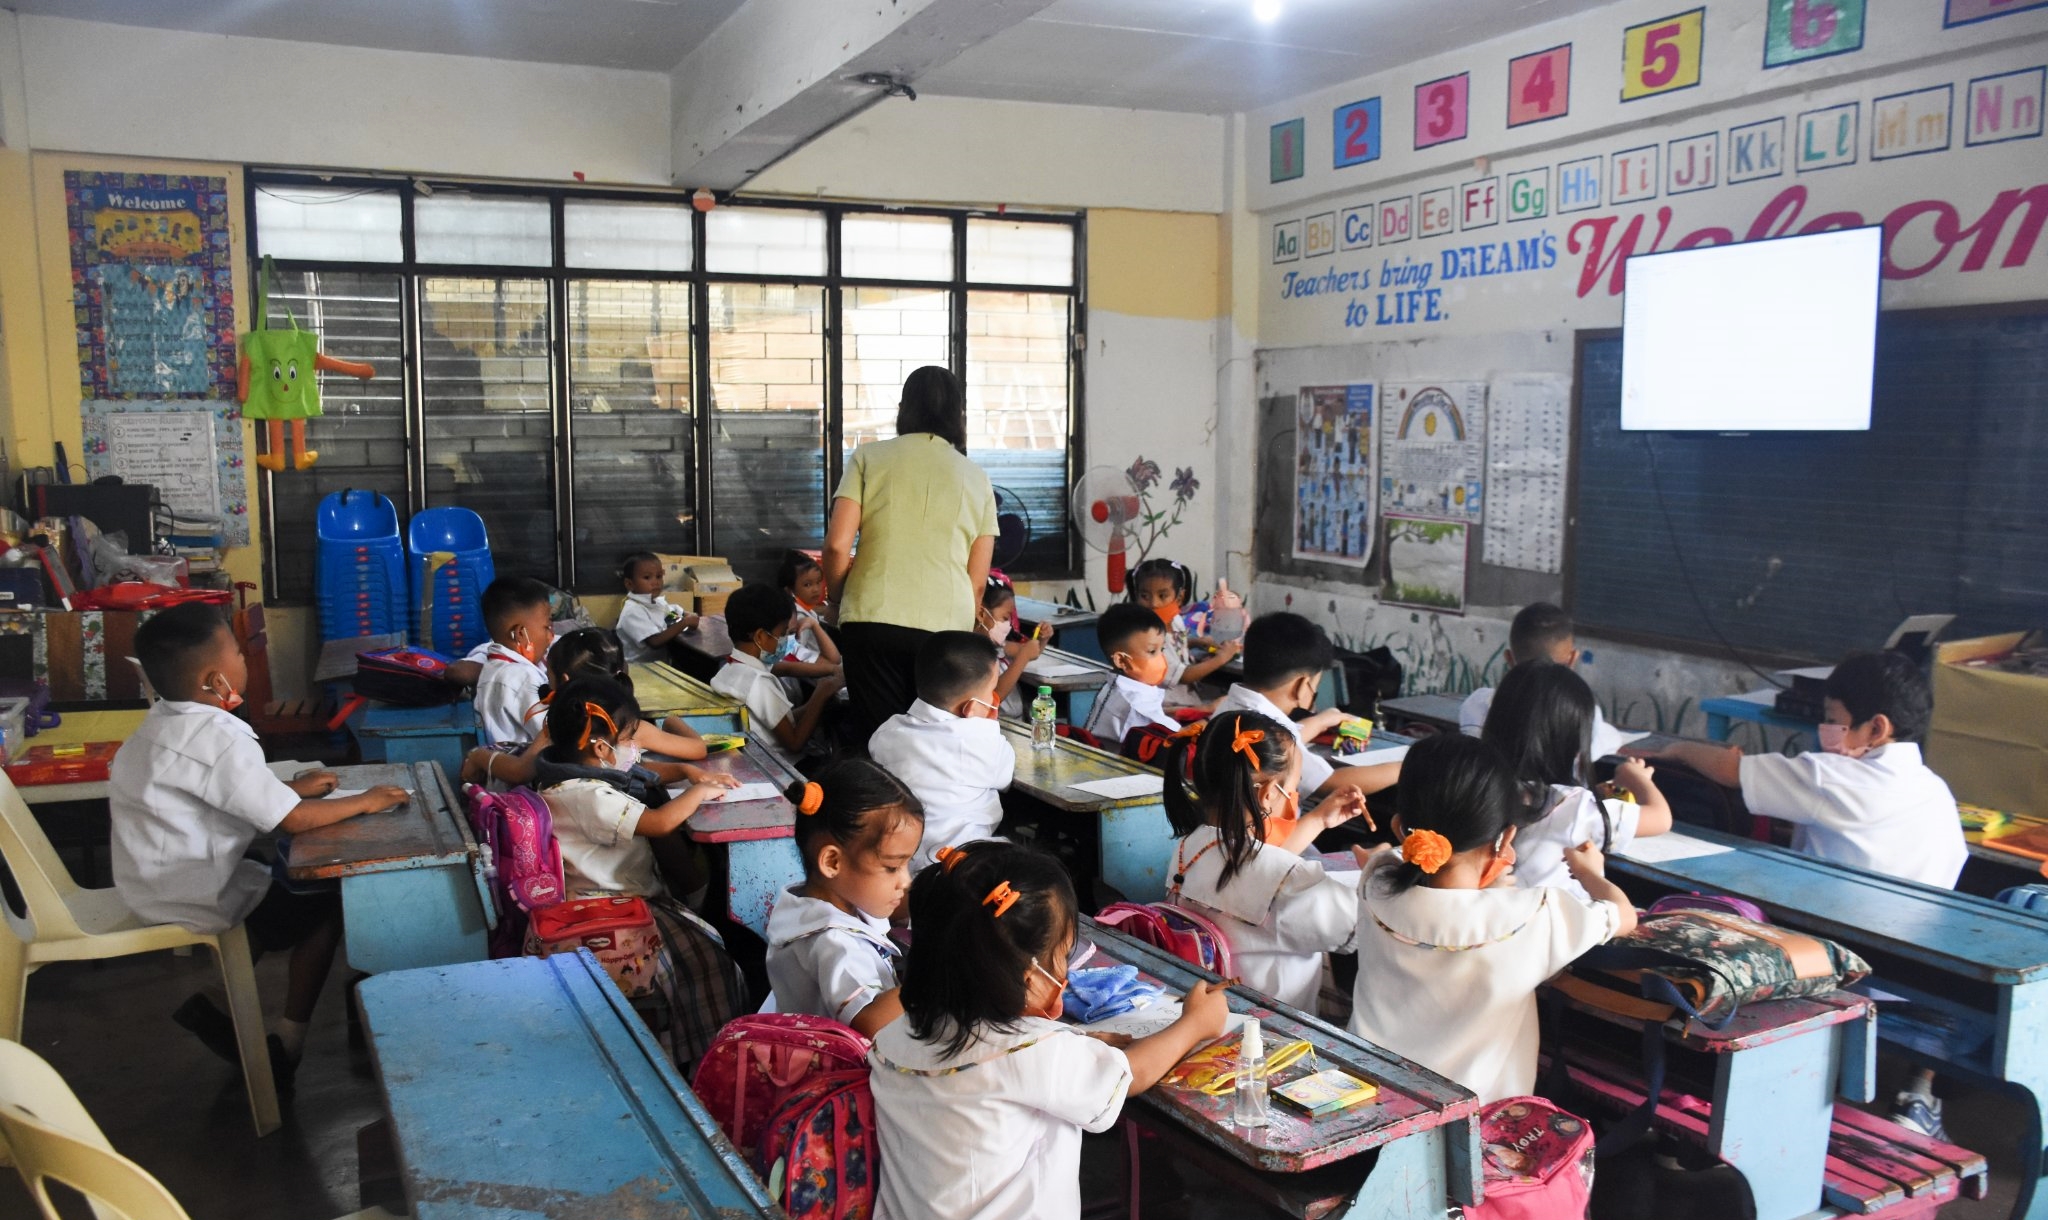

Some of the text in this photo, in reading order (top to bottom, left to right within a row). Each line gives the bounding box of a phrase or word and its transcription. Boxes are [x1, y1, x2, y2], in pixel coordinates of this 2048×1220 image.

[1281, 127, 1293, 173] 1
[1344, 109, 1369, 159] 2
[1428, 84, 1455, 138] 3
[1521, 55, 1555, 113] 4
[1641, 24, 1681, 88] 5
[108, 193, 187, 209] Welcome
[1281, 229, 1557, 299] Teachers bring DREAM'S
[1345, 287, 1448, 327] to LIFE.
[1512, 1127, 1545, 1152] TROY
